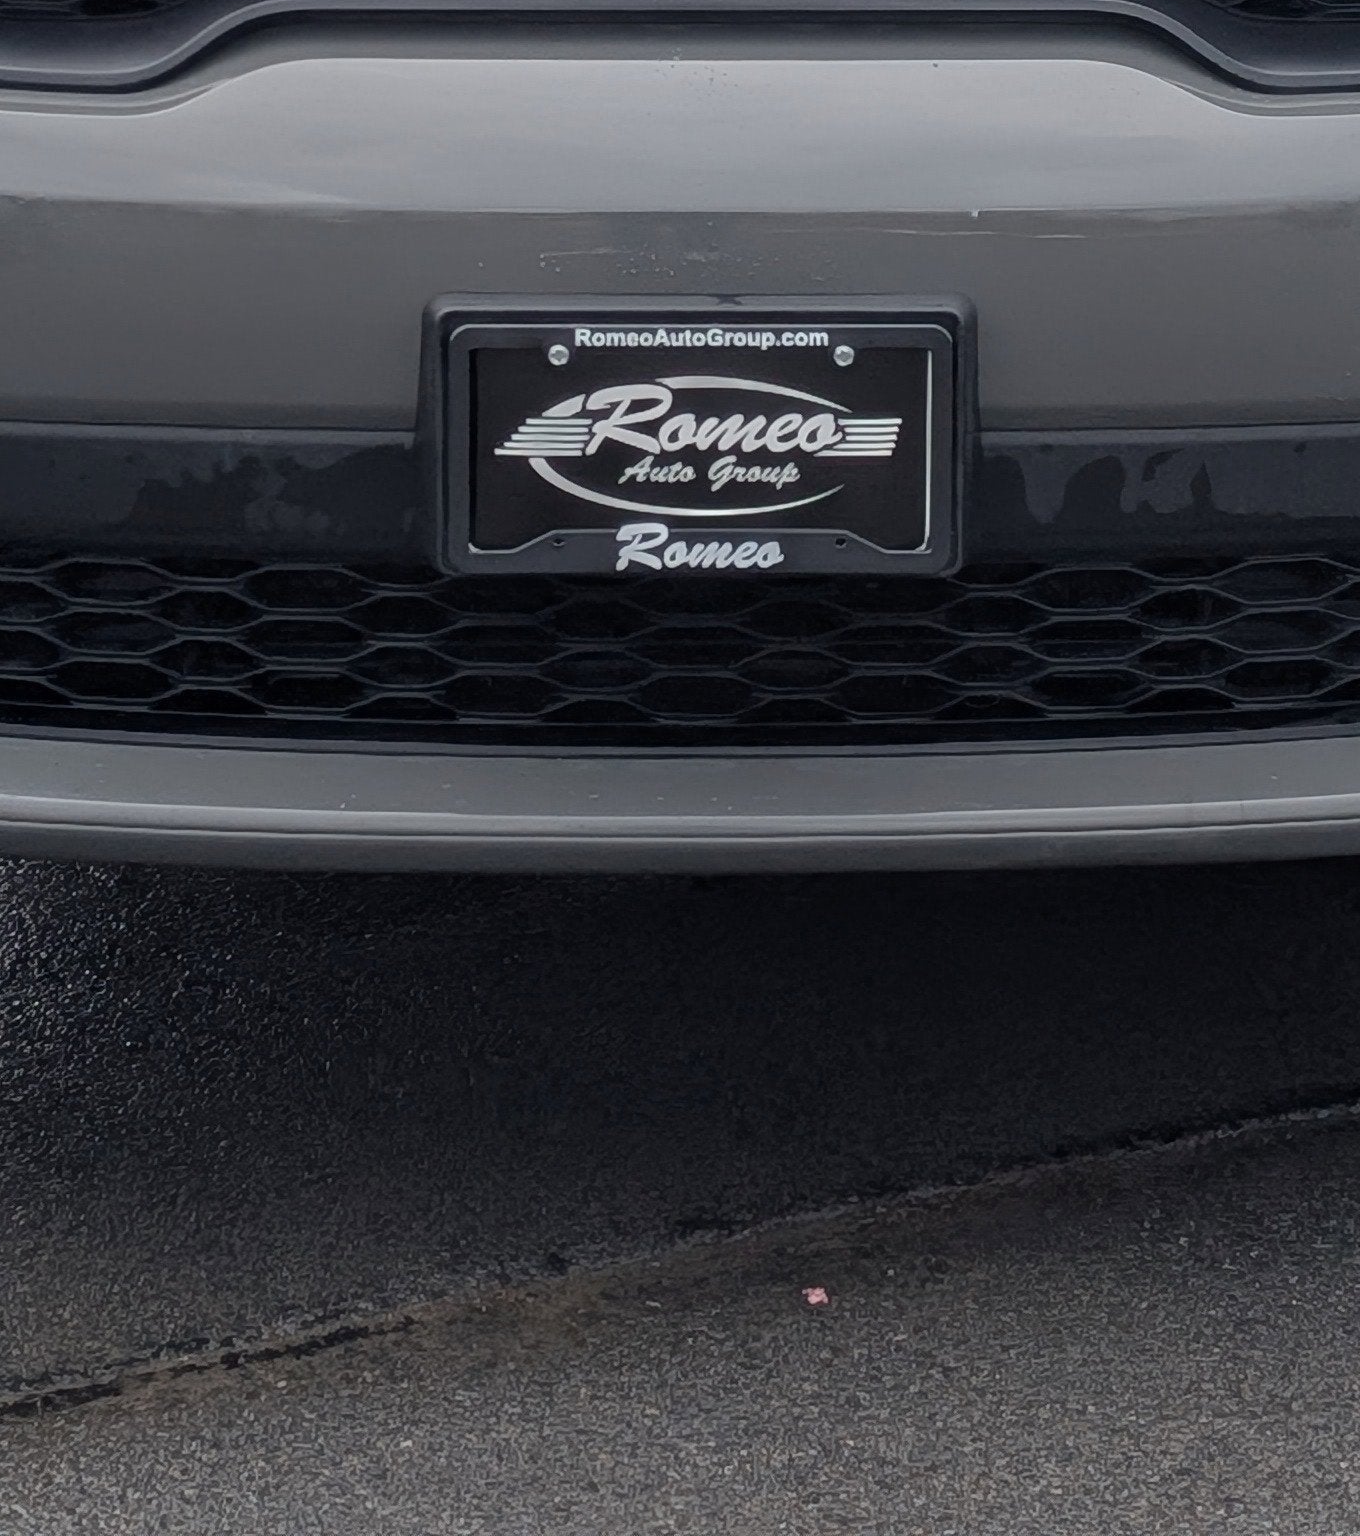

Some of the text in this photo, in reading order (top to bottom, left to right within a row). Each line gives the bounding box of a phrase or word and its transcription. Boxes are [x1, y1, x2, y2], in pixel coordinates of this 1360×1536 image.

[574, 328, 830, 351] RomeoAutoGroup.com
[585, 383, 843, 456] Romeo
[617, 455, 801, 492] Auto Group
[615, 522, 785, 571] Romeo
